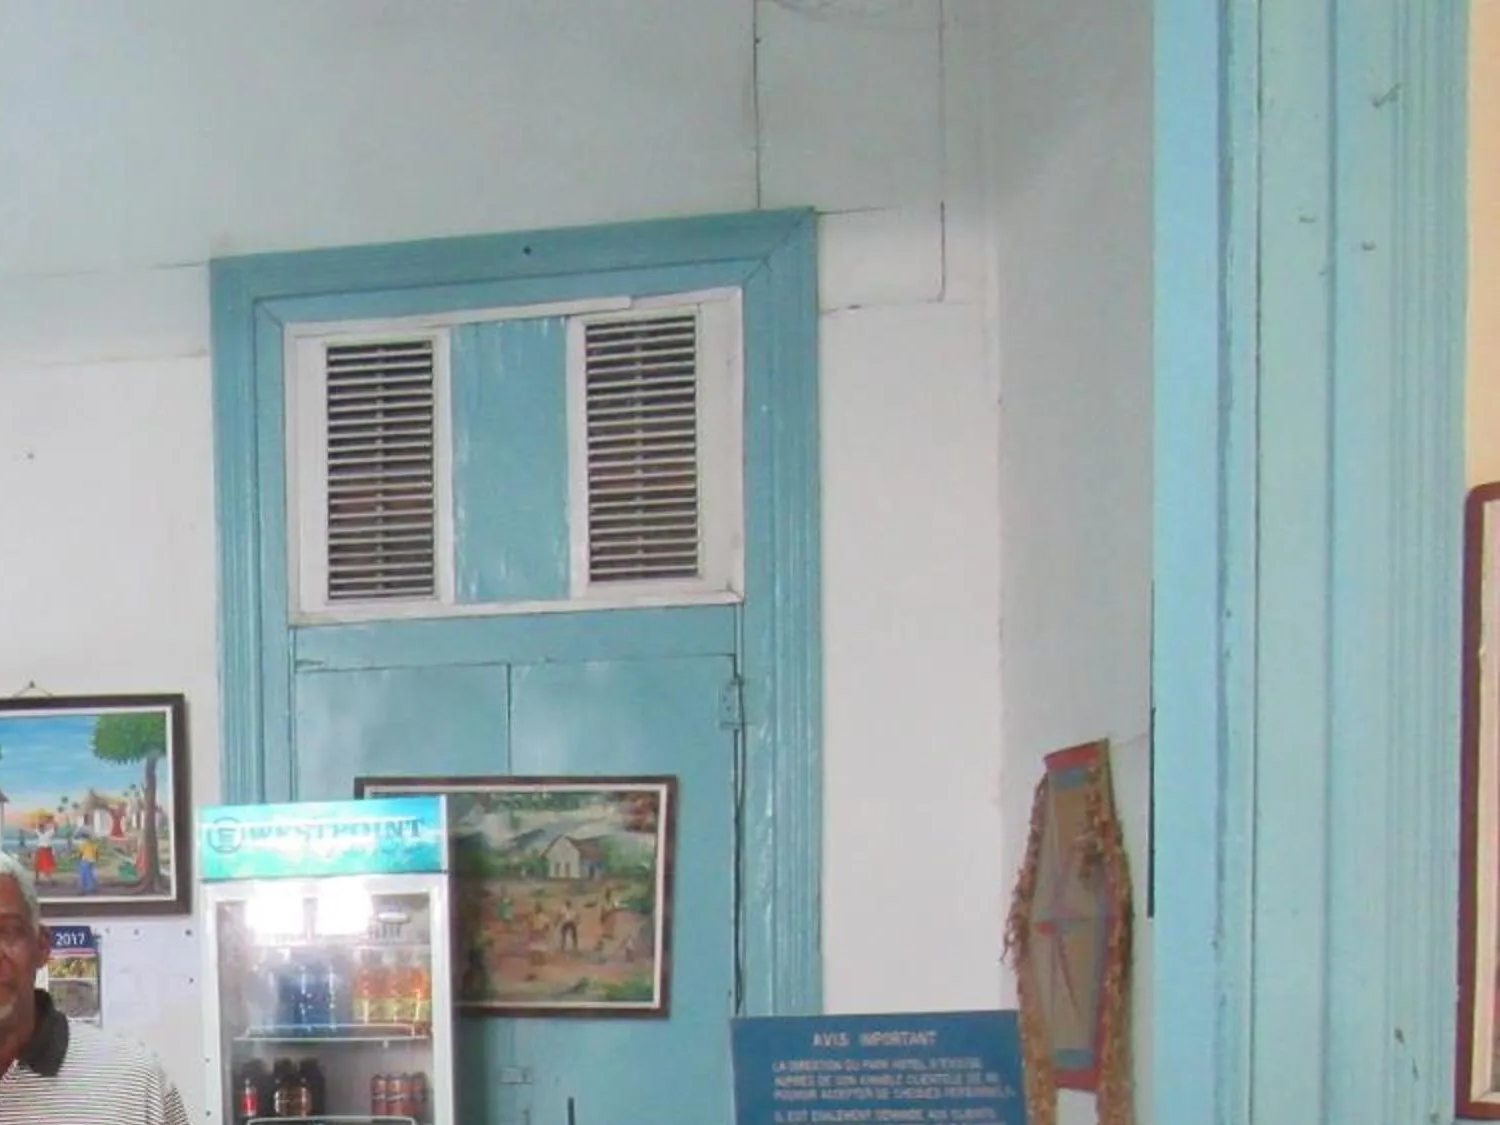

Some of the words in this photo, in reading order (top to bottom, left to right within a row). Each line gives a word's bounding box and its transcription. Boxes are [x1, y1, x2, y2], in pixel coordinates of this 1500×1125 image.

[55, 931, 85, 946] 2017
[813, 1031, 850, 1047] AVIS
[860, 1030, 938, 1046] IMPORTANT
